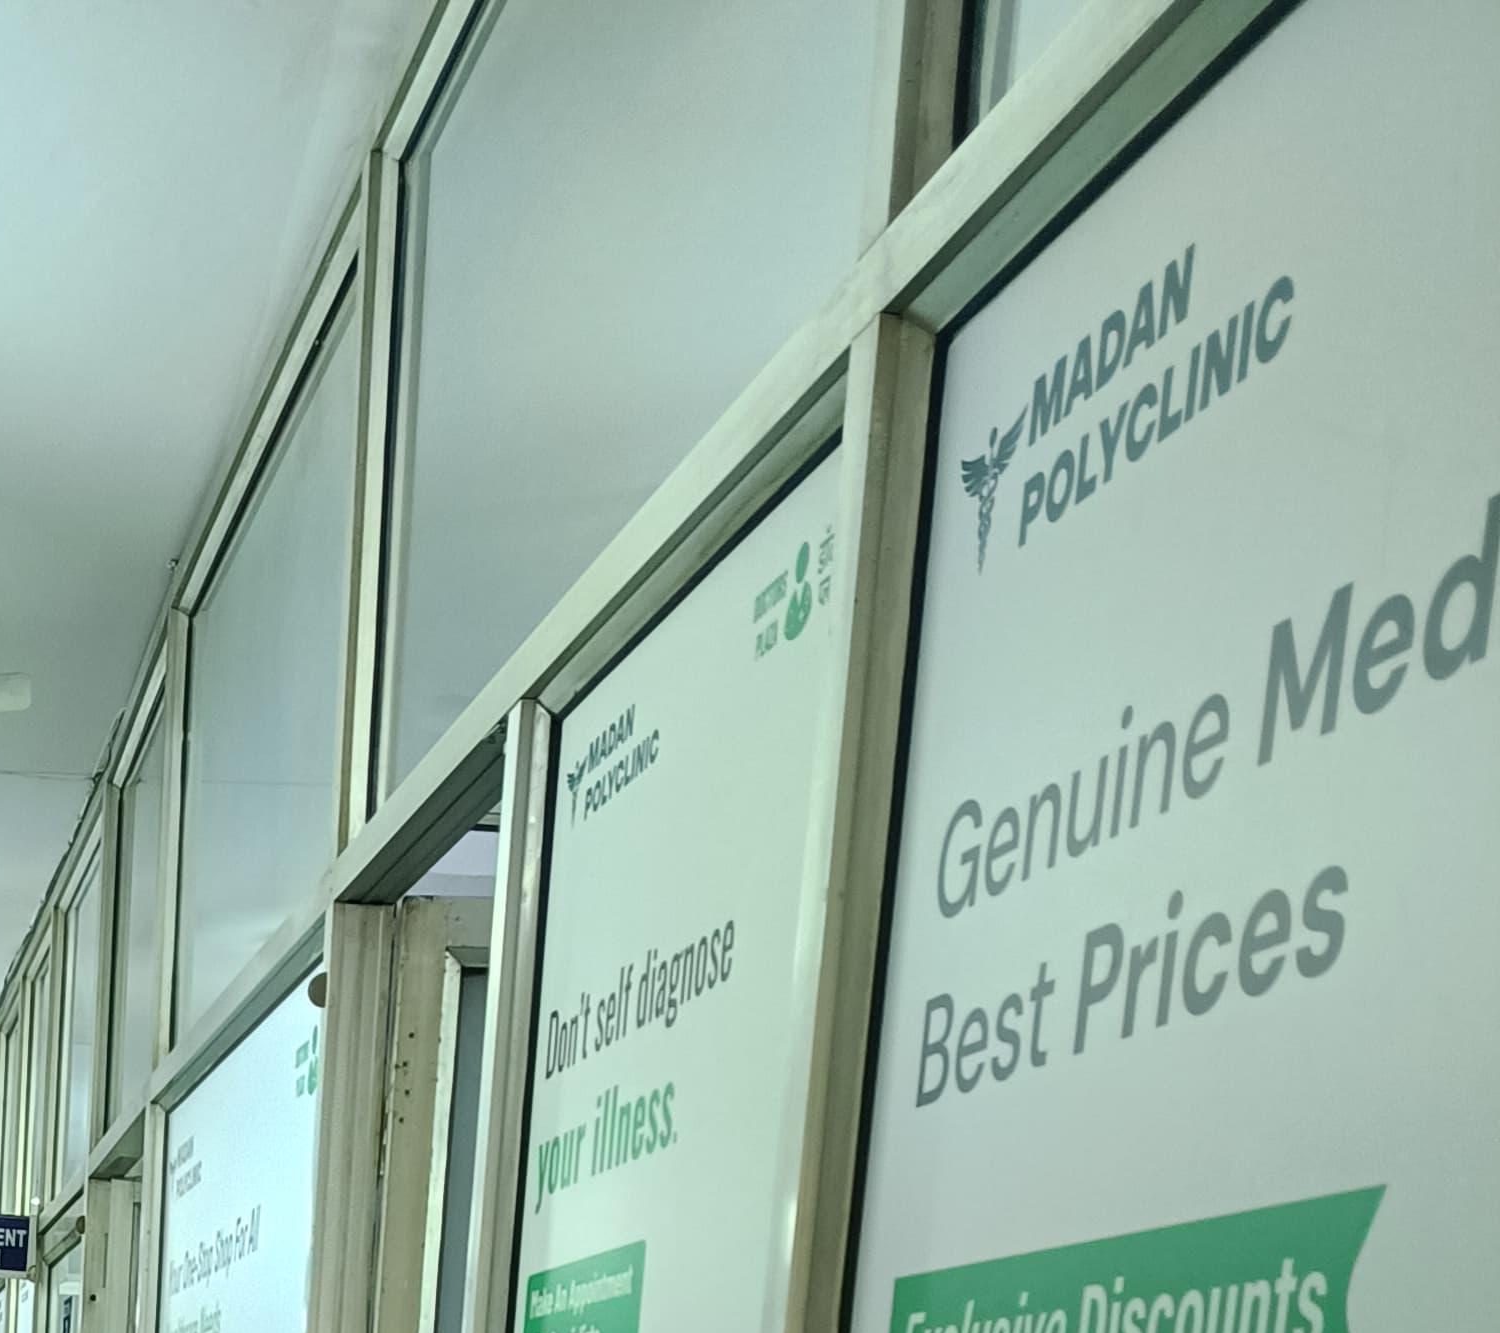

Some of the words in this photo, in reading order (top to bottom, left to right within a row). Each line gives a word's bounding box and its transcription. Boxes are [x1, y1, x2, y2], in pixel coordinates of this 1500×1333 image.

[1017, 274, 1296, 549] POLYCLINIC
[1027, 241, 1196, 448] MADAN
[584, 729, 660, 821] POLYCLINIC
[587, 703, 636, 774] MADAN
[937, 692, 1231, 919] Genuine
[1256, 490, 1500, 768] Med
[545, 991, 592, 1080] Don't
[594, 962, 635, 1053] self
[636, 919, 736, 1028] diagnose
[914, 961, 1054, 1108] Best
[1073, 864, 1350, 1057] Prices
[534, 1121, 588, 1215] your
[591, 1081, 678, 1177] illness.
[530, 1287, 554, 1321] Make
[555, 1283, 568, 1313] An
[568, 1264, 634, 1316] Appointment
